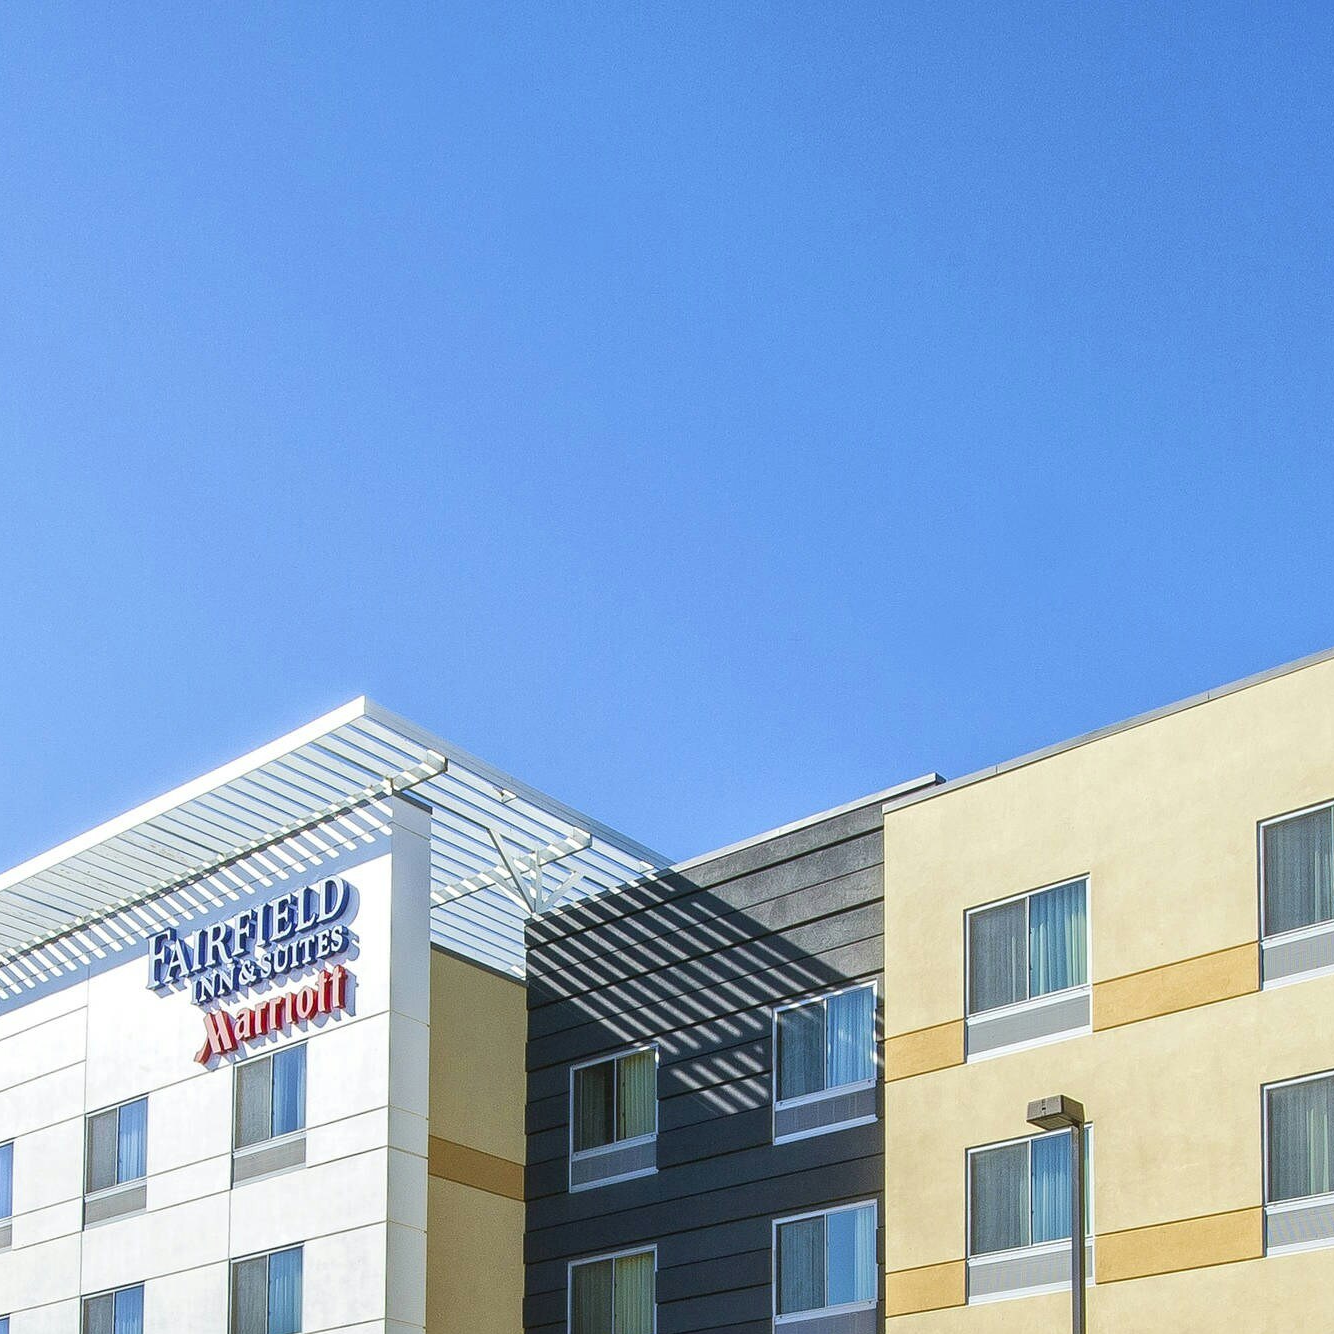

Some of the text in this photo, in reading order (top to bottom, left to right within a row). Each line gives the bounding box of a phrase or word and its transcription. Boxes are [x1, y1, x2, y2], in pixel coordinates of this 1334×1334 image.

[146, 876, 350, 990] FAIRFIELD
[191, 925, 351, 1006] INN & SUITES
[194, 964, 348, 1064] Marriott
